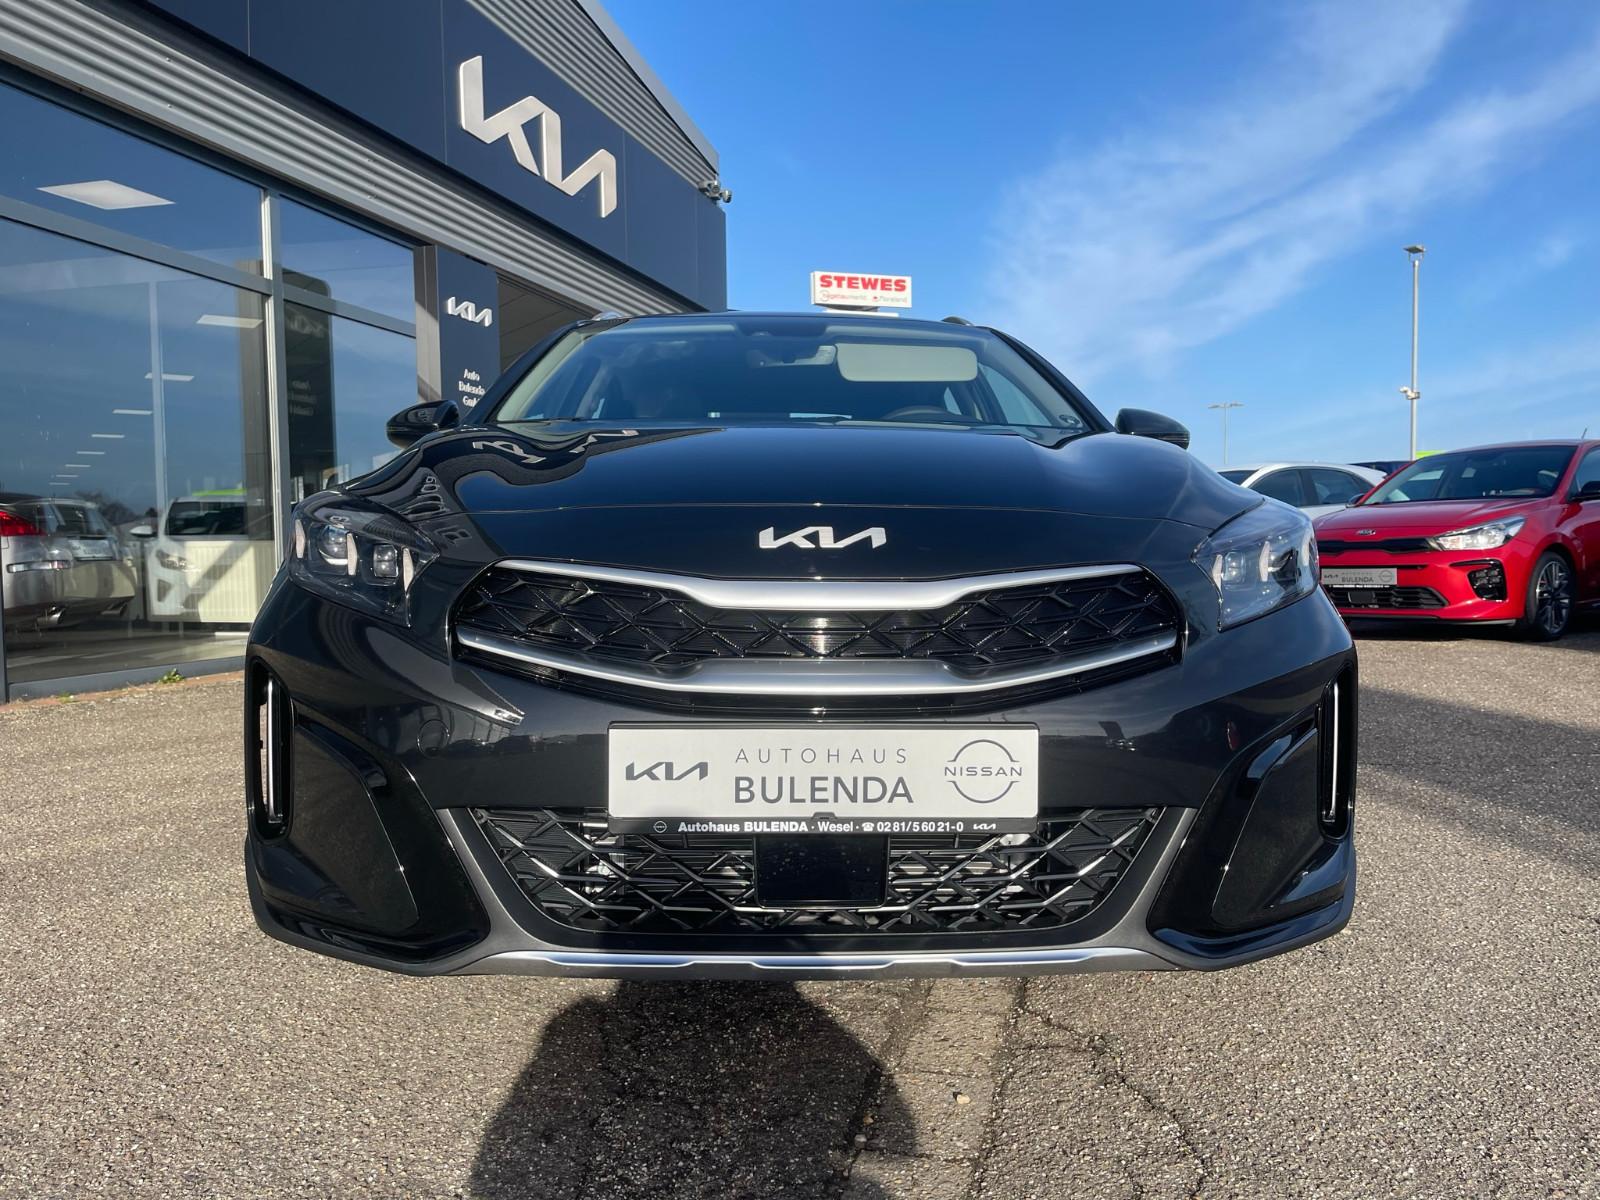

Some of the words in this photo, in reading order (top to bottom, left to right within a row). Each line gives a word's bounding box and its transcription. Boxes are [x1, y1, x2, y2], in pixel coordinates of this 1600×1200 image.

[460, 55, 618, 218] KIA
[819, 274, 906, 292] STEWES
[447, 296, 493, 327] KIA
[463, 368, 480, 382] Auto
[759, 526, 887, 549] KIA
[735, 748, 907, 764] AUTOHAUS
[625, 761, 709, 781] KIA
[944, 766, 1023, 777] NISSAN
[734, 776, 914, 804] BULENDA
[678, 821, 740, 832] Autohaus
[744, 821, 809, 832] BULENDA
[818, 821, 854, 832] Wesel
